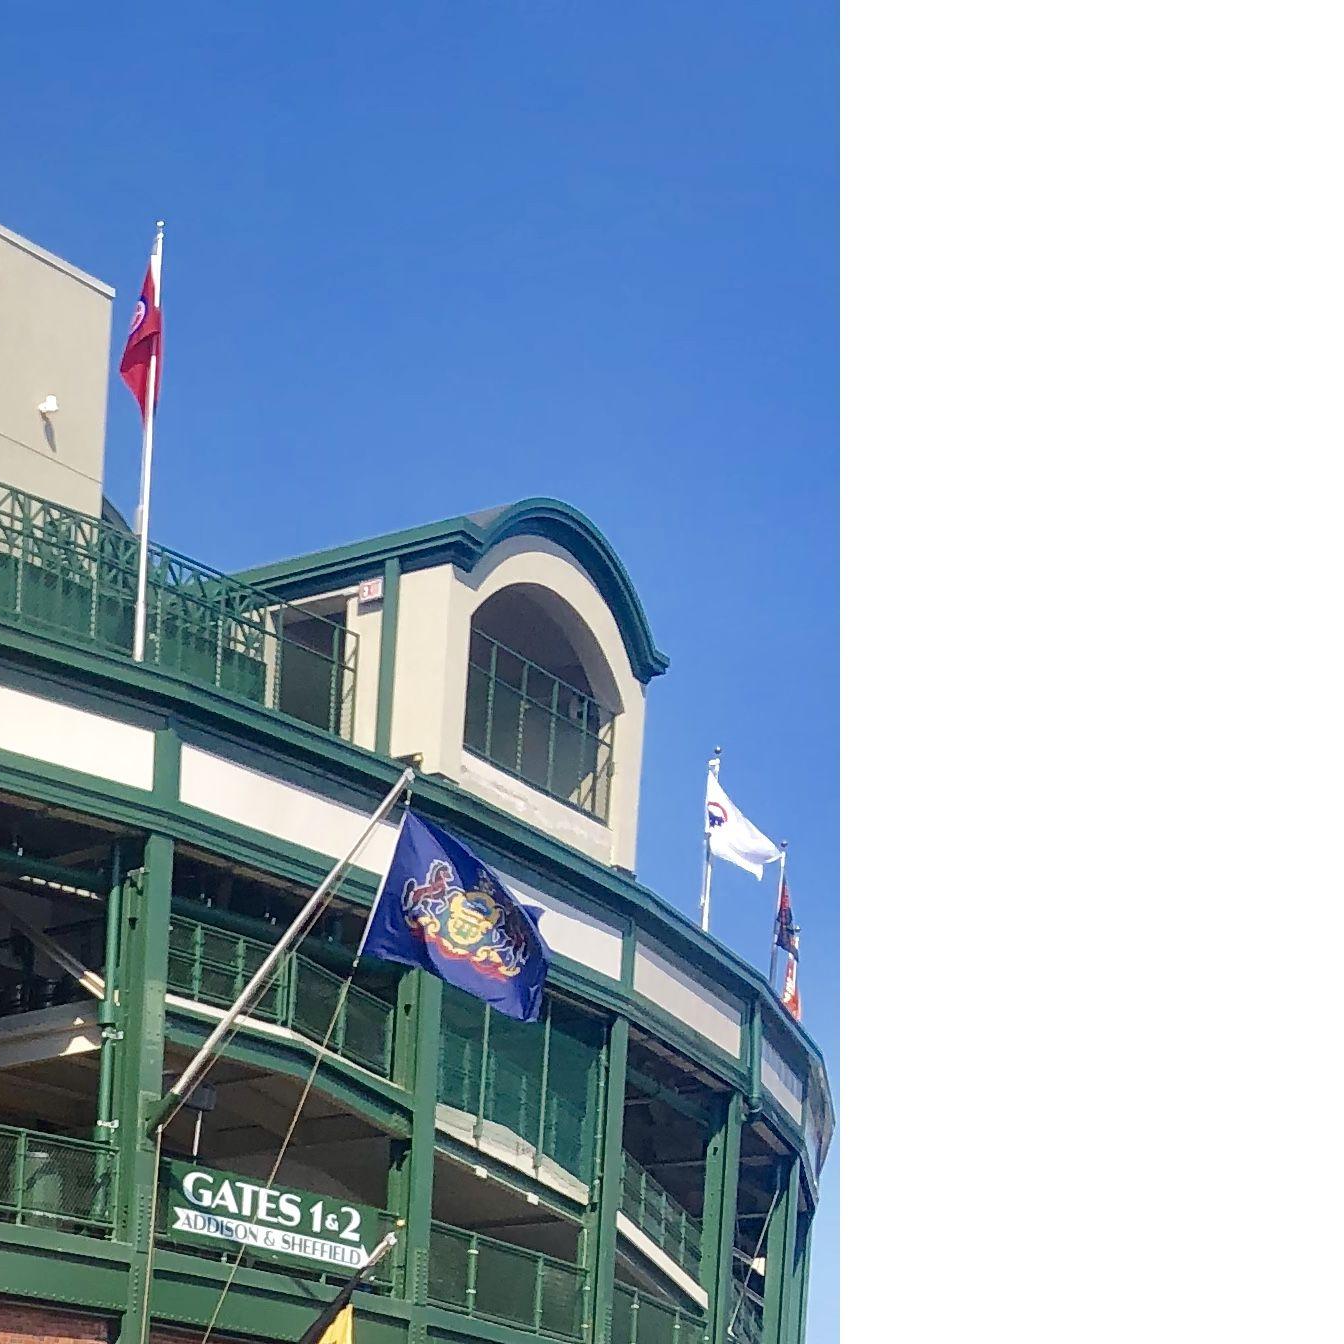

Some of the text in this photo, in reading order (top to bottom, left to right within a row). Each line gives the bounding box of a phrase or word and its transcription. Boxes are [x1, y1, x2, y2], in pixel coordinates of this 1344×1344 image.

[182, 1171, 302, 1227] GATES
[181, 1212, 361, 1266] ADDISON & SHEFFIELD
